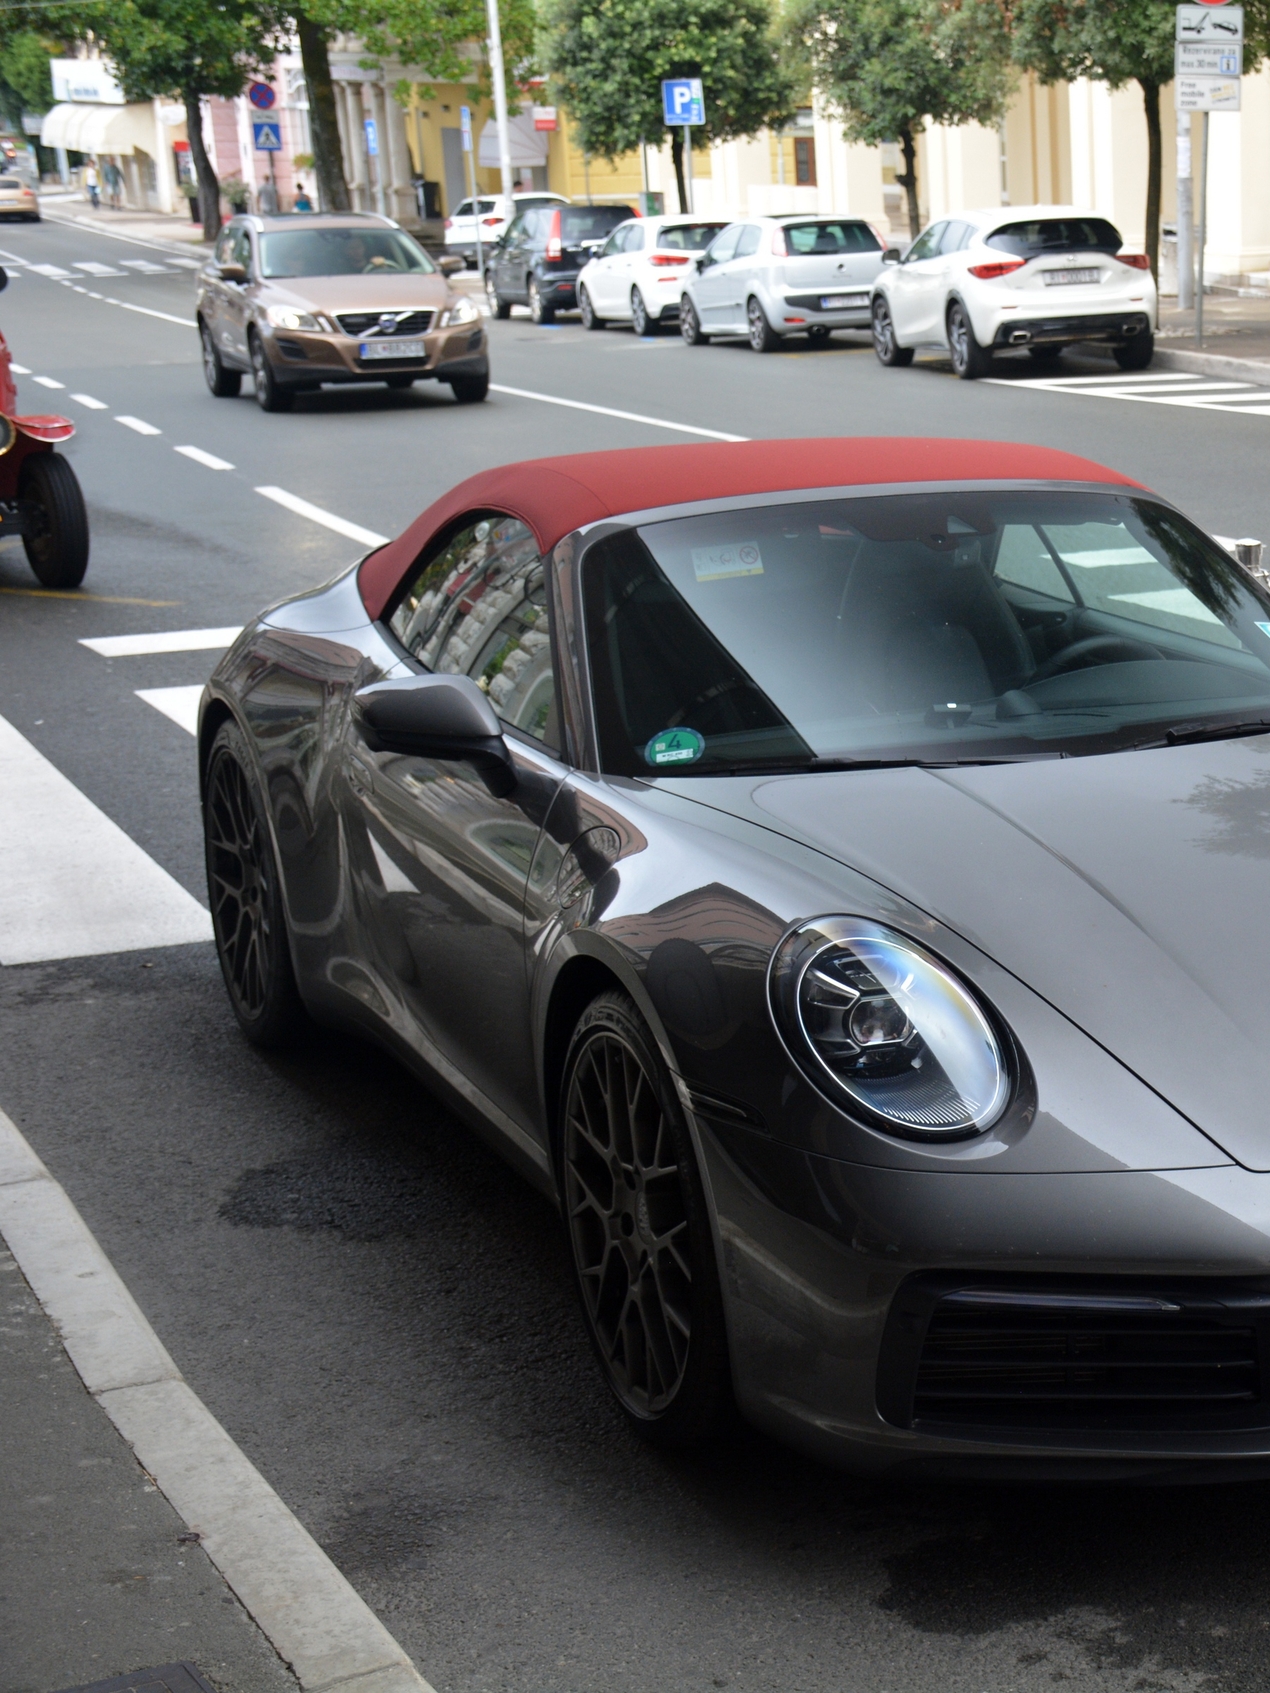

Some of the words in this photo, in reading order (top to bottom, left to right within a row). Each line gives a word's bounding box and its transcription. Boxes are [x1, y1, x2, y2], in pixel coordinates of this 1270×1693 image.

[1196, 59, 1205, 68] 30
[673, 86, 691, 114] P
[668, 733, 682, 749] 4
